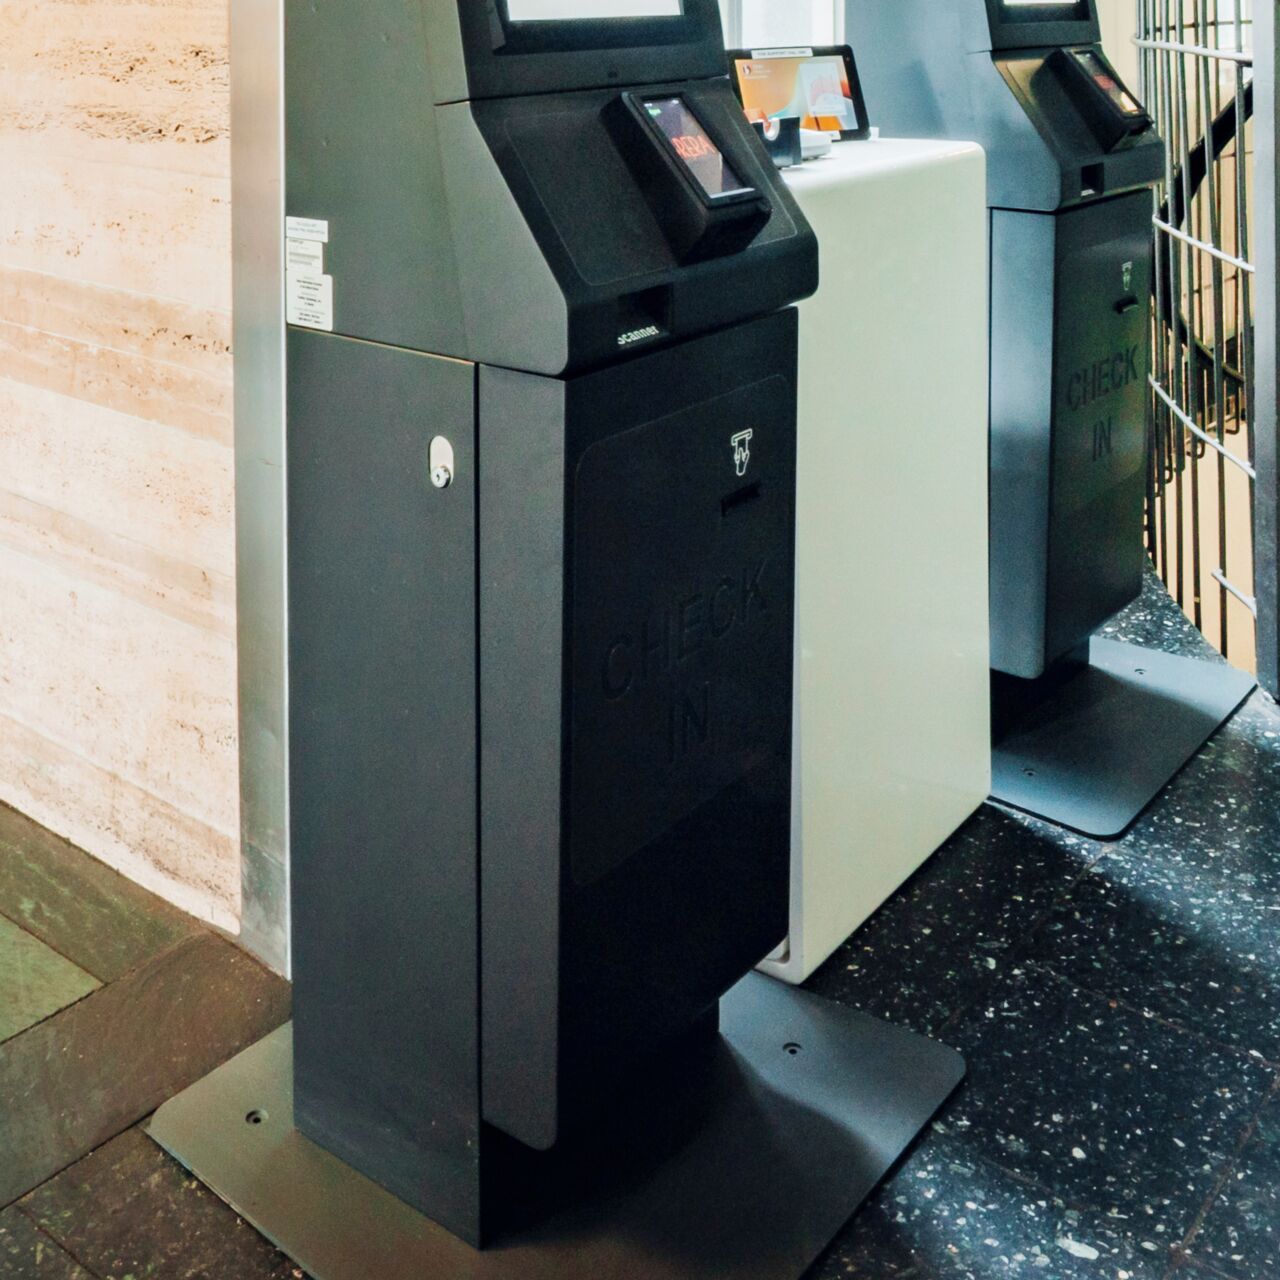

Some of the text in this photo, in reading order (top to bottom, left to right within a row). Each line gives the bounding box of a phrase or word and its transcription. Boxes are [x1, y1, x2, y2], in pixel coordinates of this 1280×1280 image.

[1066, 343, 1138, 412] CHECK
[1092, 417, 1113, 462] IN
[602, 559, 768, 702] CHECK
[666, 680, 710, 767] IN
